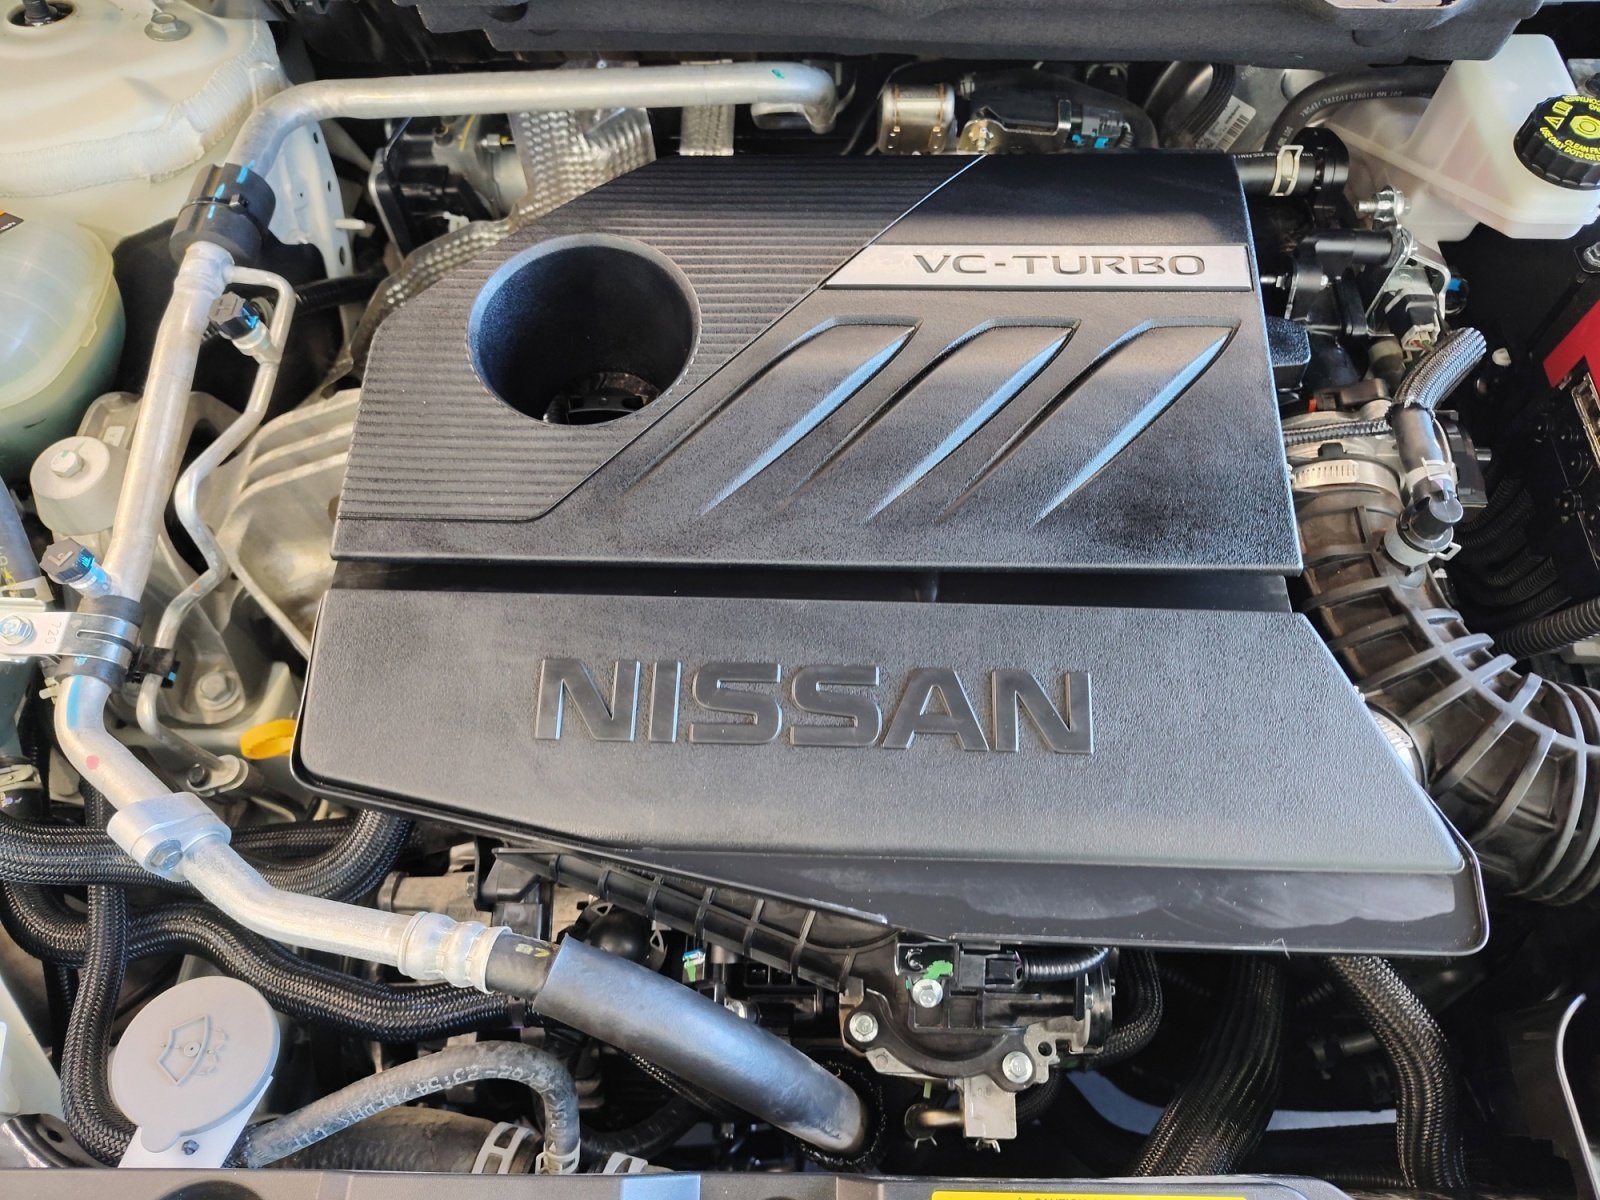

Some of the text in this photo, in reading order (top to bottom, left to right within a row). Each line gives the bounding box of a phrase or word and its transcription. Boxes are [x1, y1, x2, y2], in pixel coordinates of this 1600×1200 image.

[1548, 136, 1566, 150] ONLY
[1564, 139, 1589, 153] CLEAN
[913, 254, 1206, 276] VC-TURBO
[535, 657, 1095, 755] NISSAN
